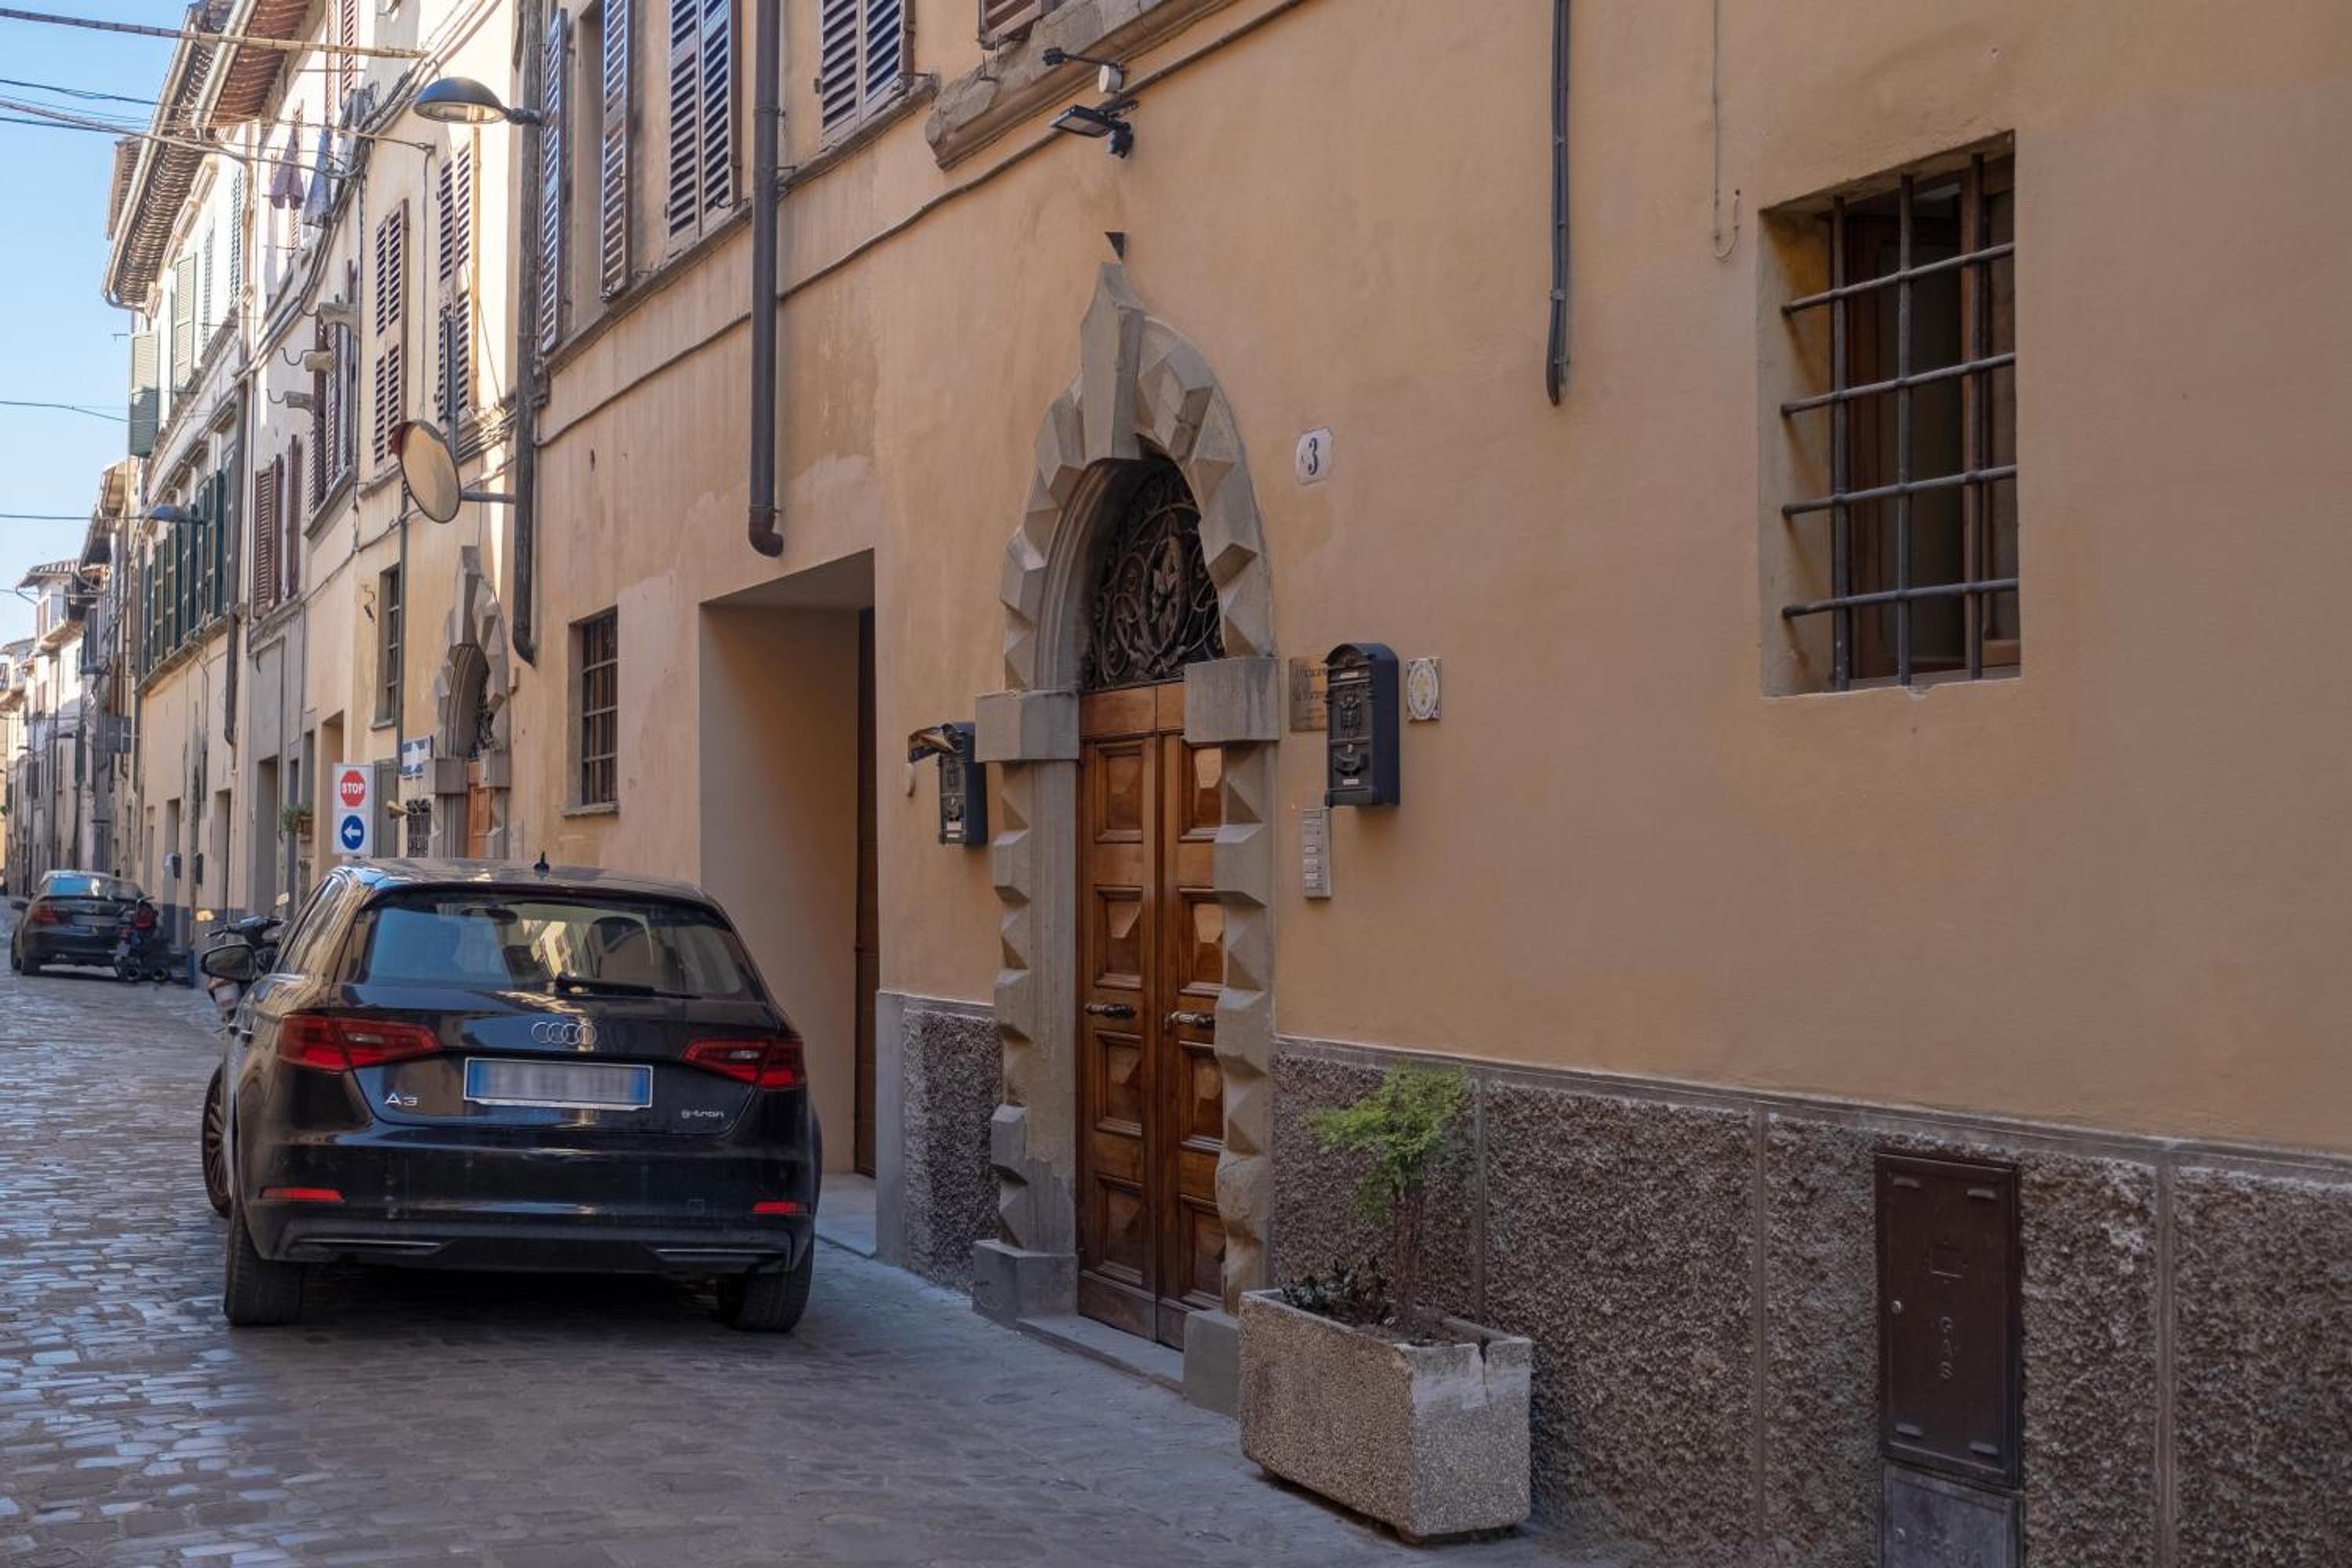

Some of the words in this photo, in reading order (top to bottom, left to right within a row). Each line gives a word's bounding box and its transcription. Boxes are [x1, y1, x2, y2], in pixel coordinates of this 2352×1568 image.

[1308, 437, 1319, 476] 3
[342, 782, 365, 794] STOP
[383, 1091, 418, 1106] A3
[1937, 1316, 1956, 1381] GAS
